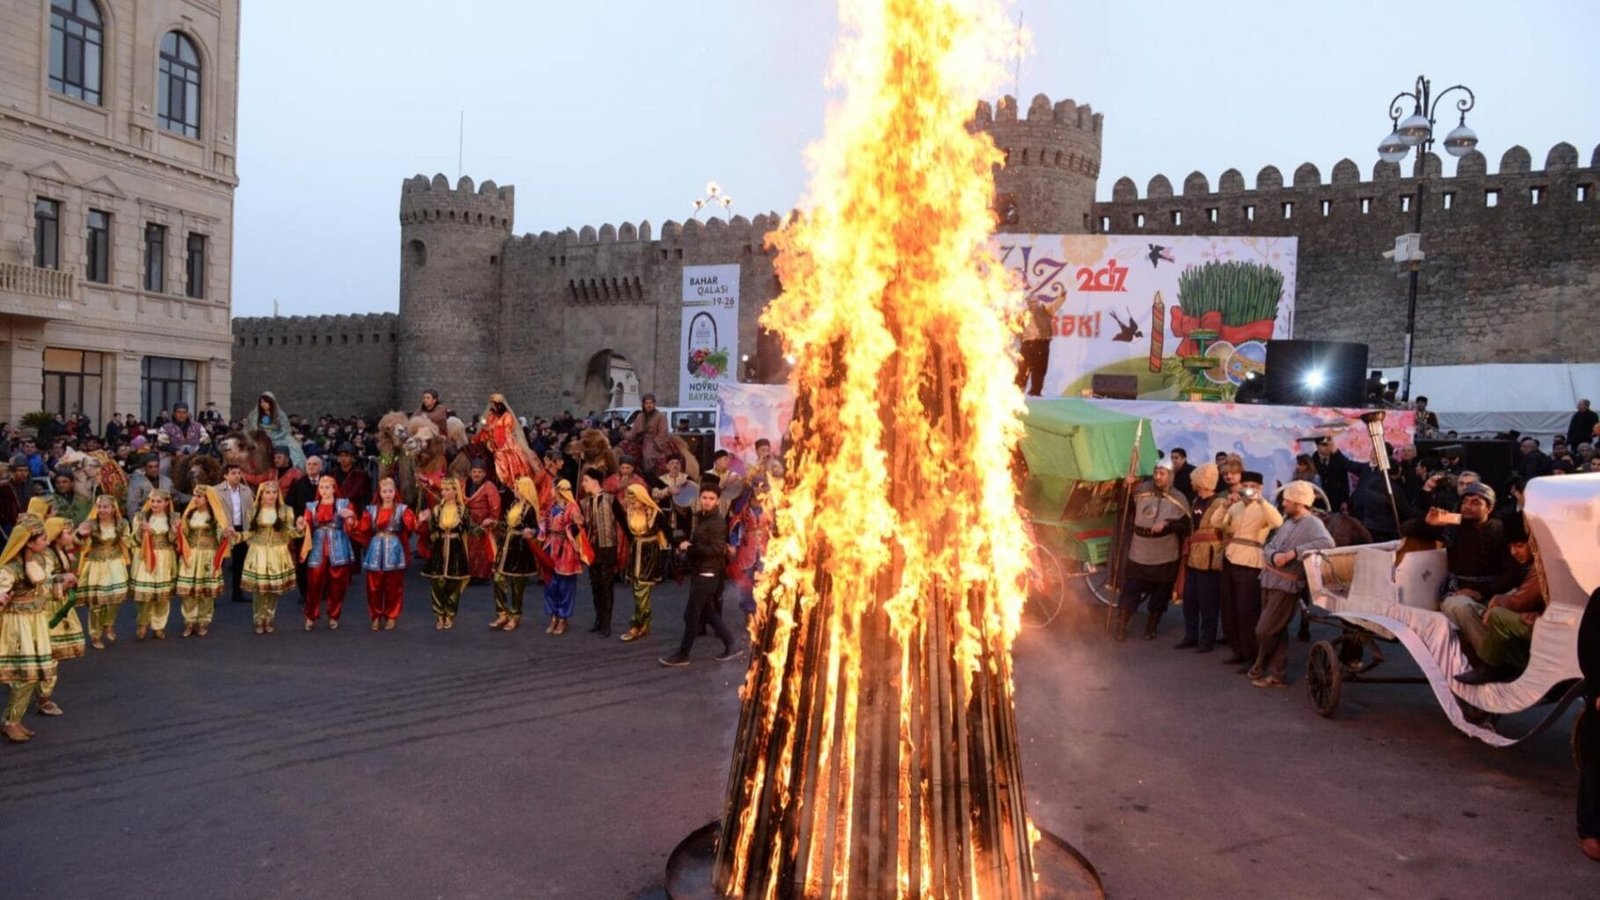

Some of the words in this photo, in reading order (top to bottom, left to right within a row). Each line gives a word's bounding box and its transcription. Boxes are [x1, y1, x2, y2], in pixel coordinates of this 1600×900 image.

[690, 276, 718, 285] BAHAR
[698, 285, 728, 296] QALASI
[713, 297, 735, 305] 19-26
[690, 382, 719, 391] NOVRU
